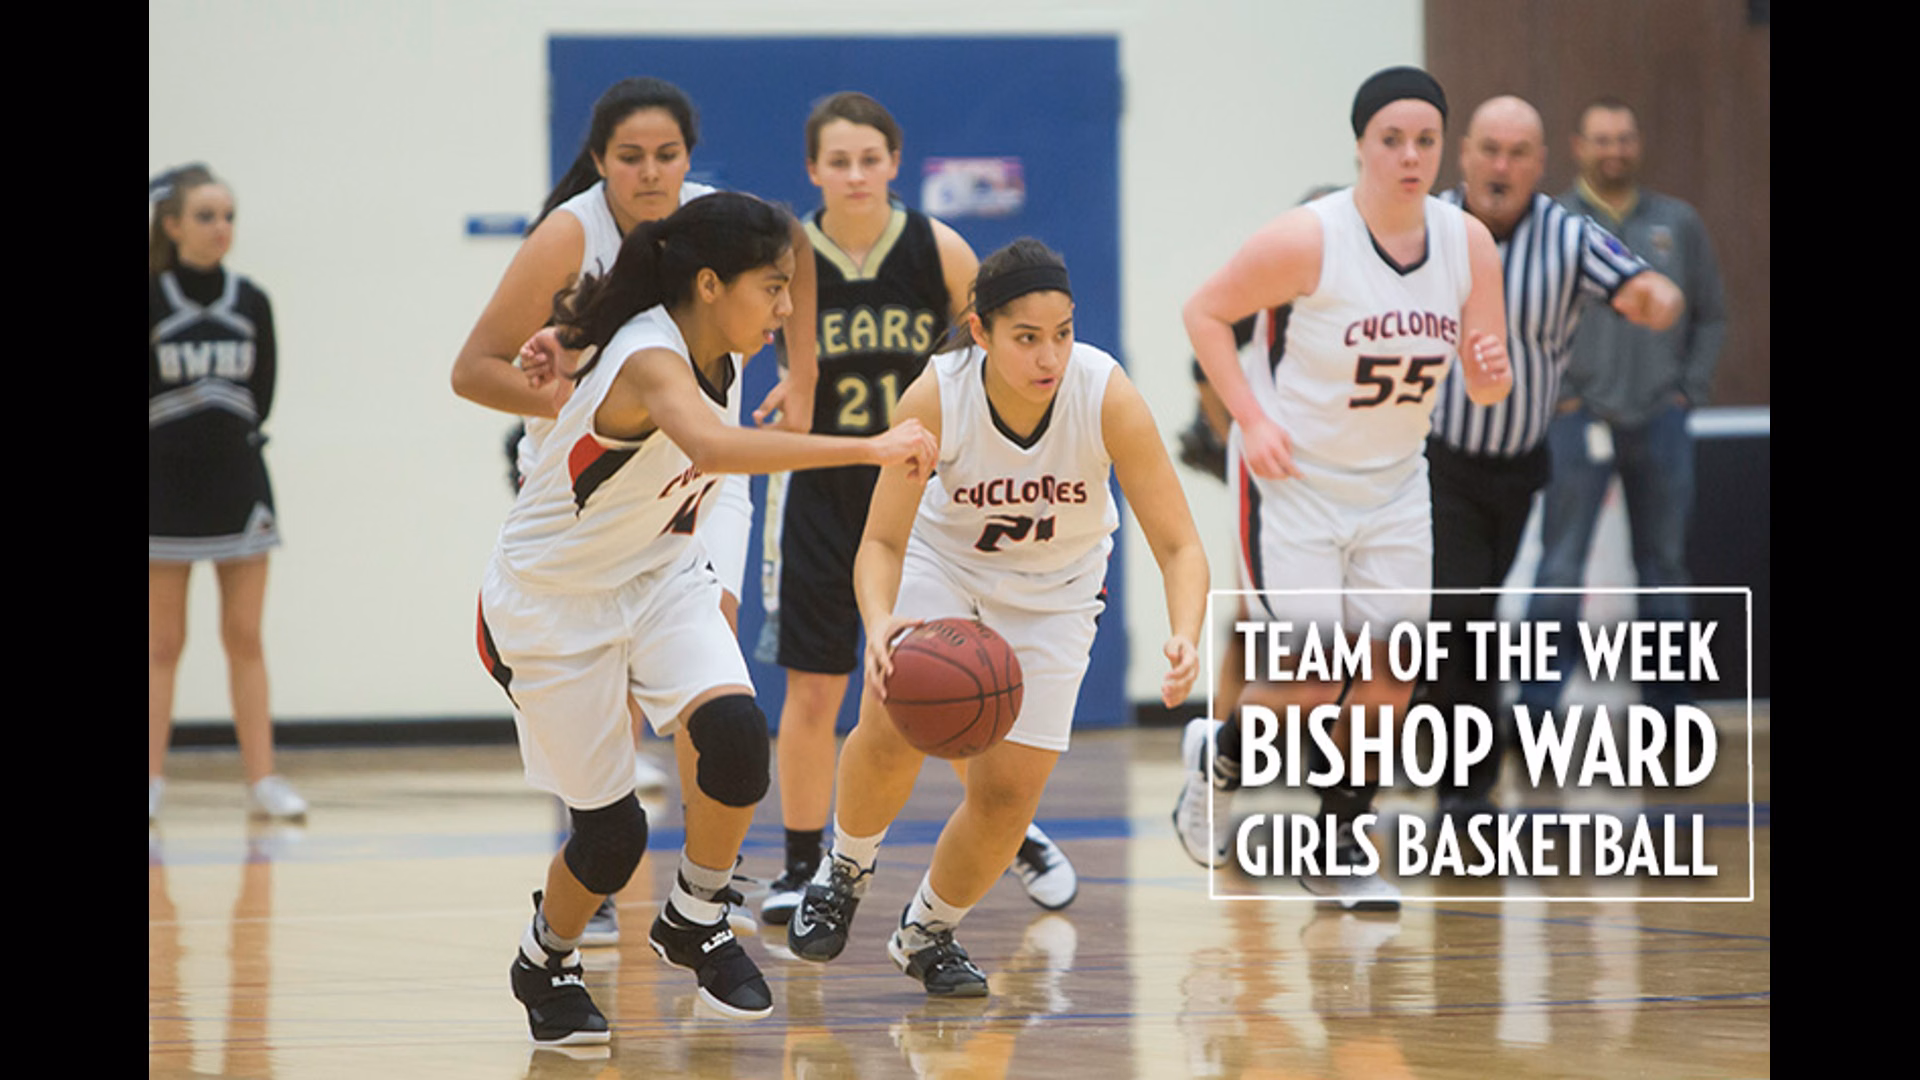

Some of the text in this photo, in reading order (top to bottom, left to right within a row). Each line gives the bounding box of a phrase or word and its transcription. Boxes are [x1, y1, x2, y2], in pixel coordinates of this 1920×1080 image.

[816, 308, 934, 356] EARS
[1344, 310, 1458, 346] CYCLONES
[836, 373, 897, 427] 21
[1348, 355, 1446, 409] 55
[953, 474, 1088, 508] CYCLONES
